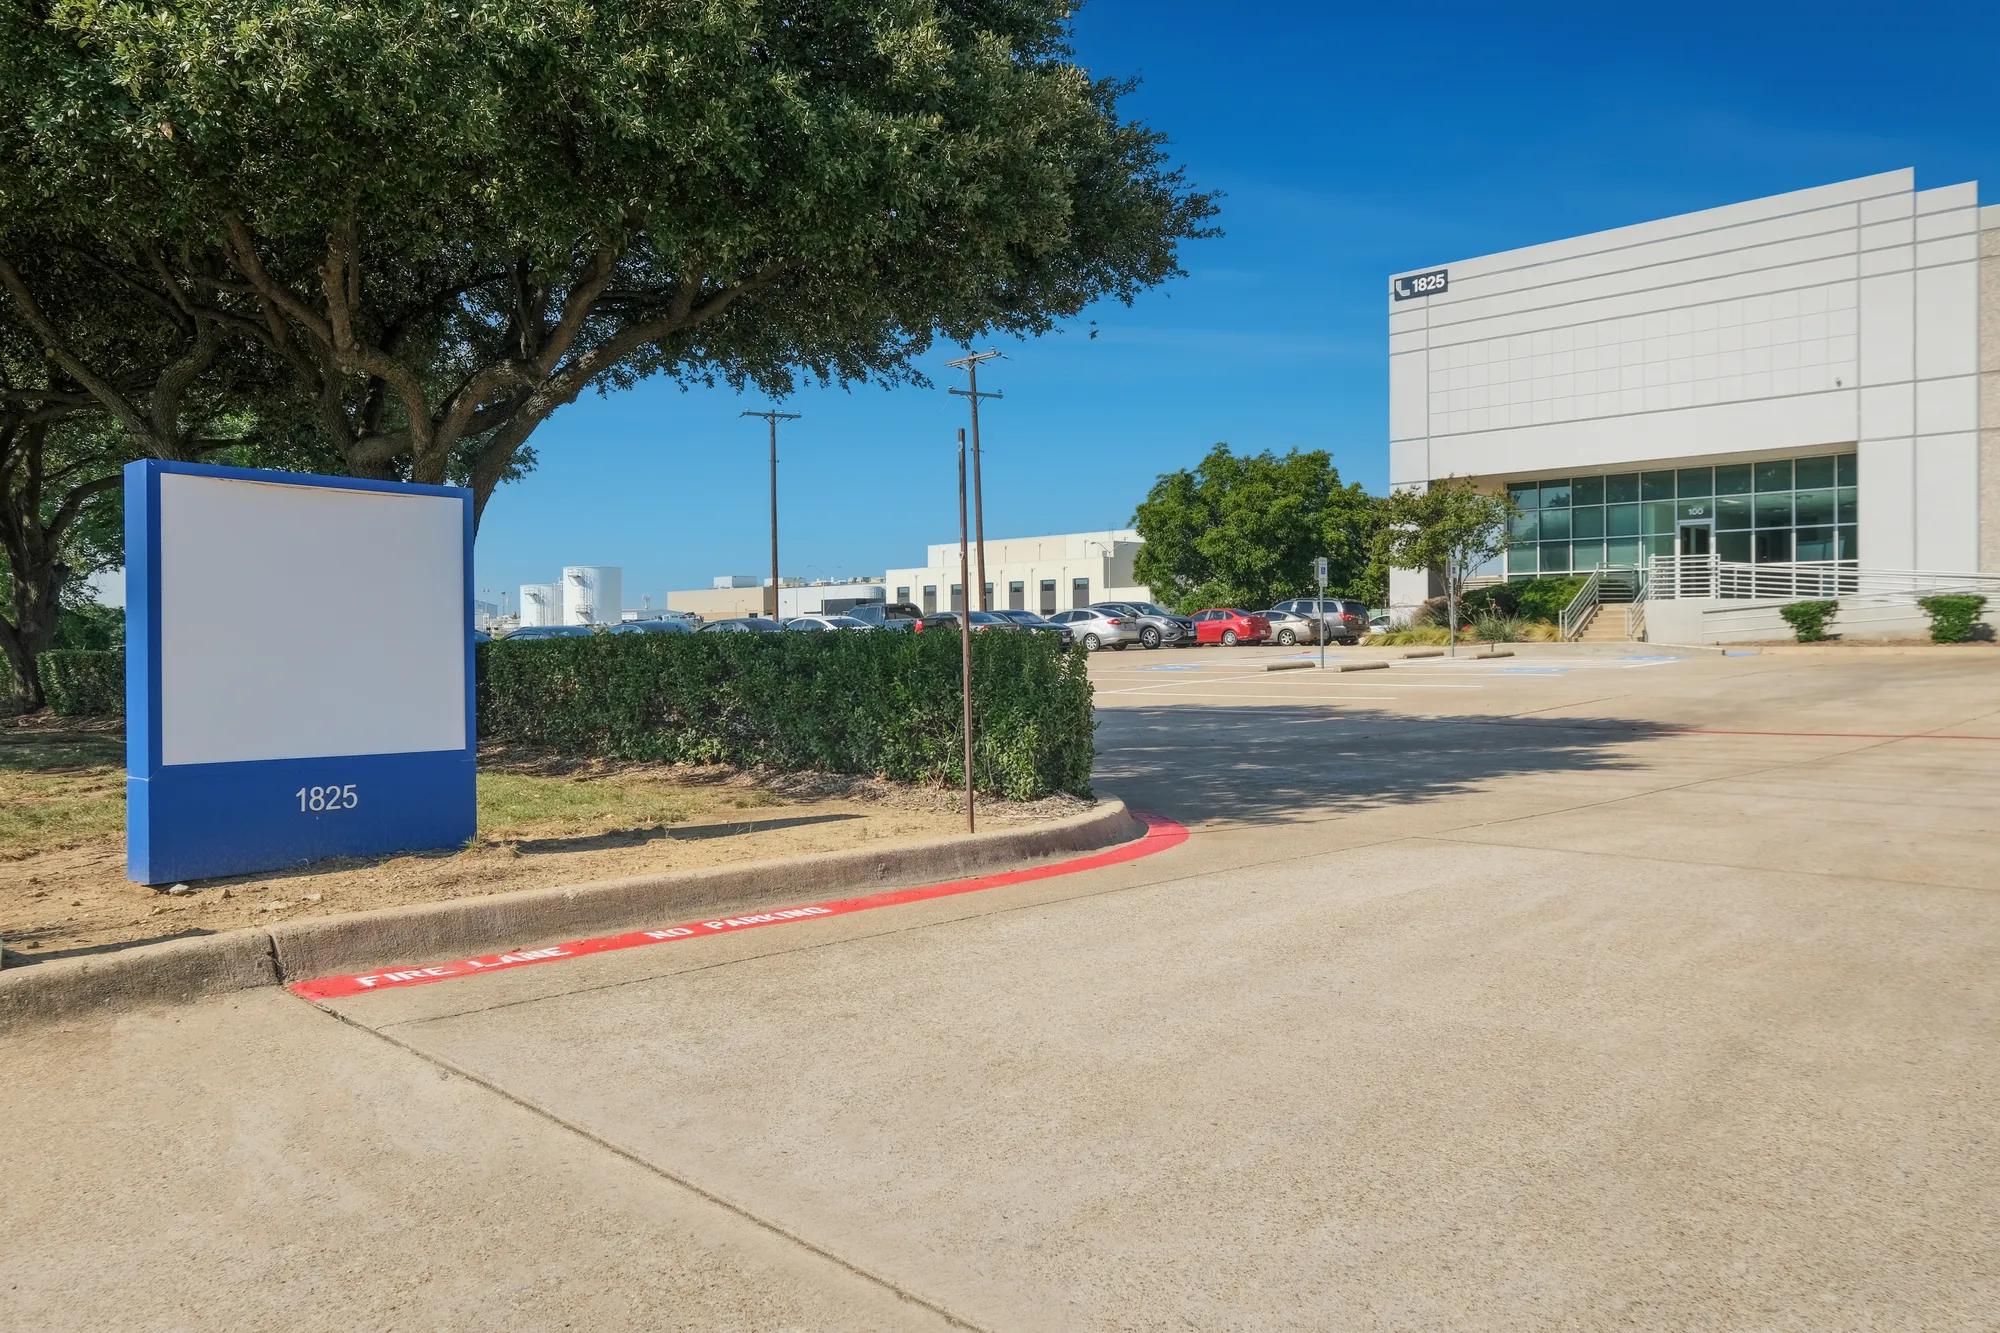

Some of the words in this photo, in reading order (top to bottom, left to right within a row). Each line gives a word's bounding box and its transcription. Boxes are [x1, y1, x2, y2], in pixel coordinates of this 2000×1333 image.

[1412, 273, 1445, 292] 1825
[1687, 507, 1704, 516] 100
[295, 784, 359, 812] 1825
[355, 966, 456, 987] FIRE
[468, 946, 572, 969] LANE
[643, 927, 694, 940] NO
[702, 906, 833, 930] PARKING
